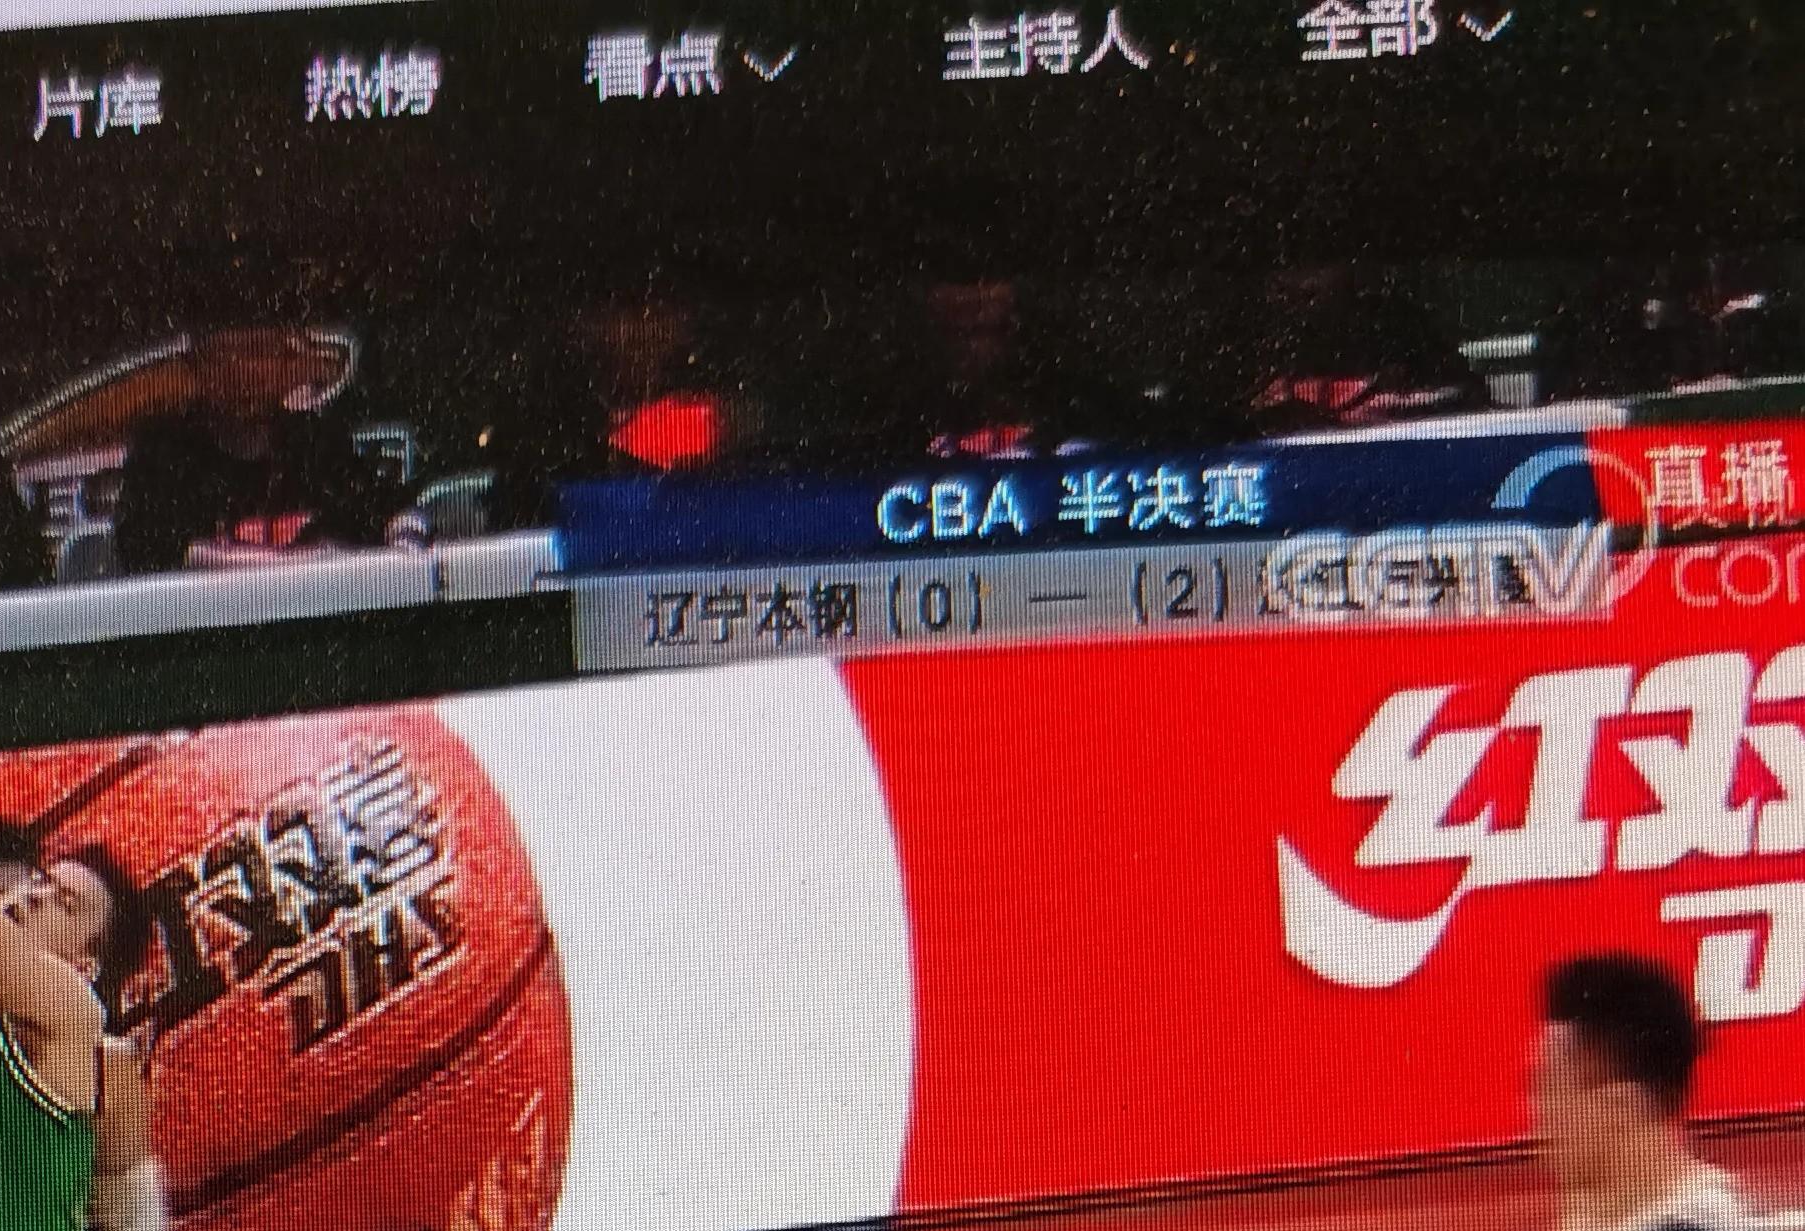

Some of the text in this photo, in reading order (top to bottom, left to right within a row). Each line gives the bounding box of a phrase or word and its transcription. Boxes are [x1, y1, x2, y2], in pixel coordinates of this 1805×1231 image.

[942, 6, 1150, 81] 主持人
[1297, 0, 1436, 60] 全部
[585, 31, 722, 103] 看点
[33, 72, 162, 142] 片库
[877, 461, 1265, 544] CBA 半决赛
